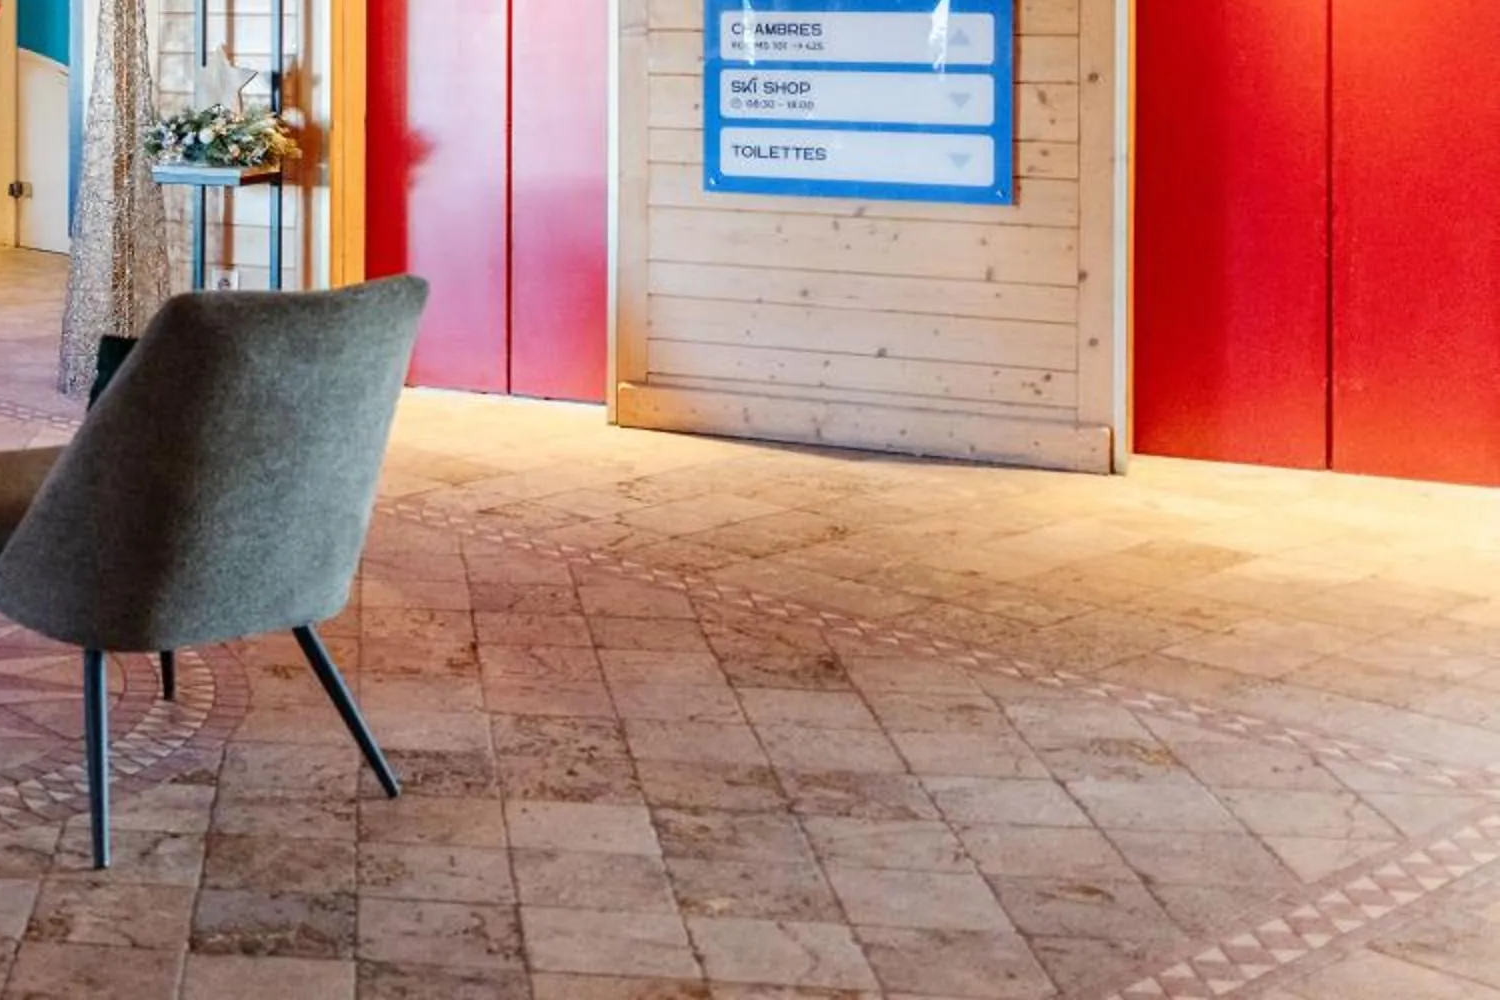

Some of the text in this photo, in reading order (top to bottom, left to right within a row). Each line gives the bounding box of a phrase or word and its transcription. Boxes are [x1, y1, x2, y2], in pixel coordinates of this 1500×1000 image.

[731, 23, 823, 37] CAMBRES
[731, 78, 811, 95] SKI SHOP
[732, 145, 828, 161] TOILETTES
